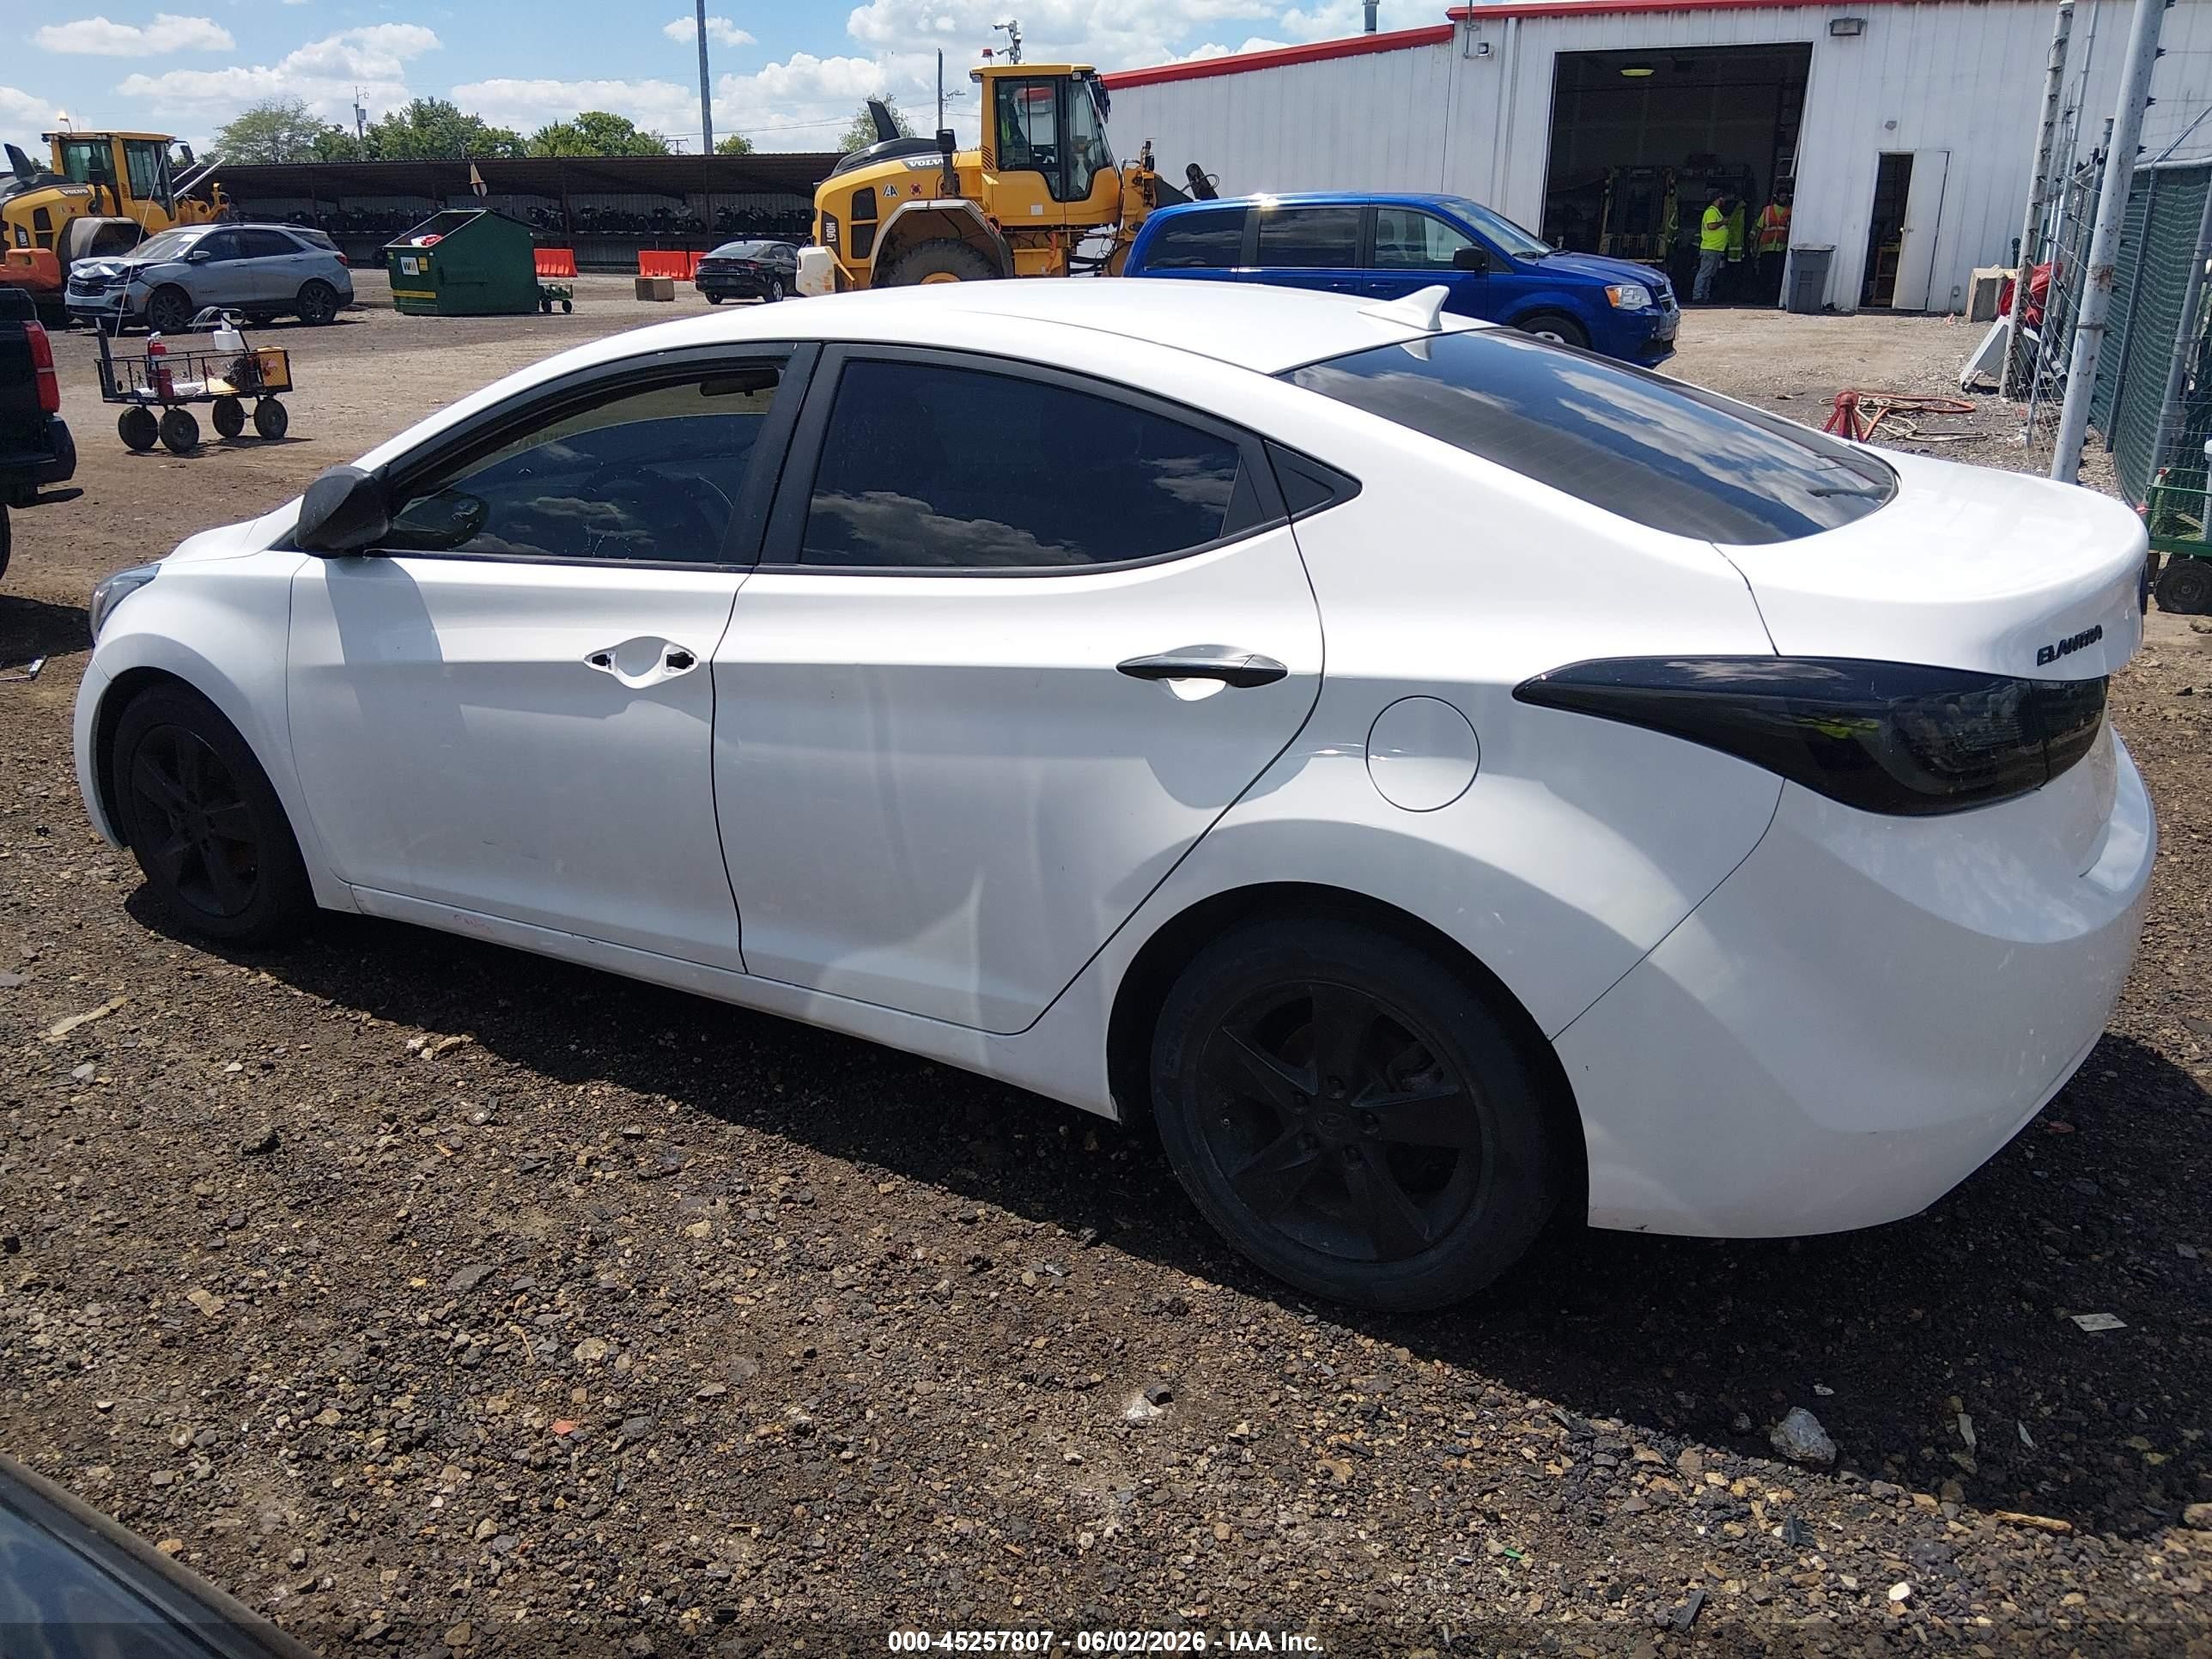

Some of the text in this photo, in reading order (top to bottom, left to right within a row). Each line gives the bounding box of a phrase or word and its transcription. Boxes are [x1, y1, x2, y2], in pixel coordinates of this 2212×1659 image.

[908, 158, 944, 167] VOLV
[825, 222, 837, 242] L90H
[2037, 624, 2103, 666] ELANTRA
